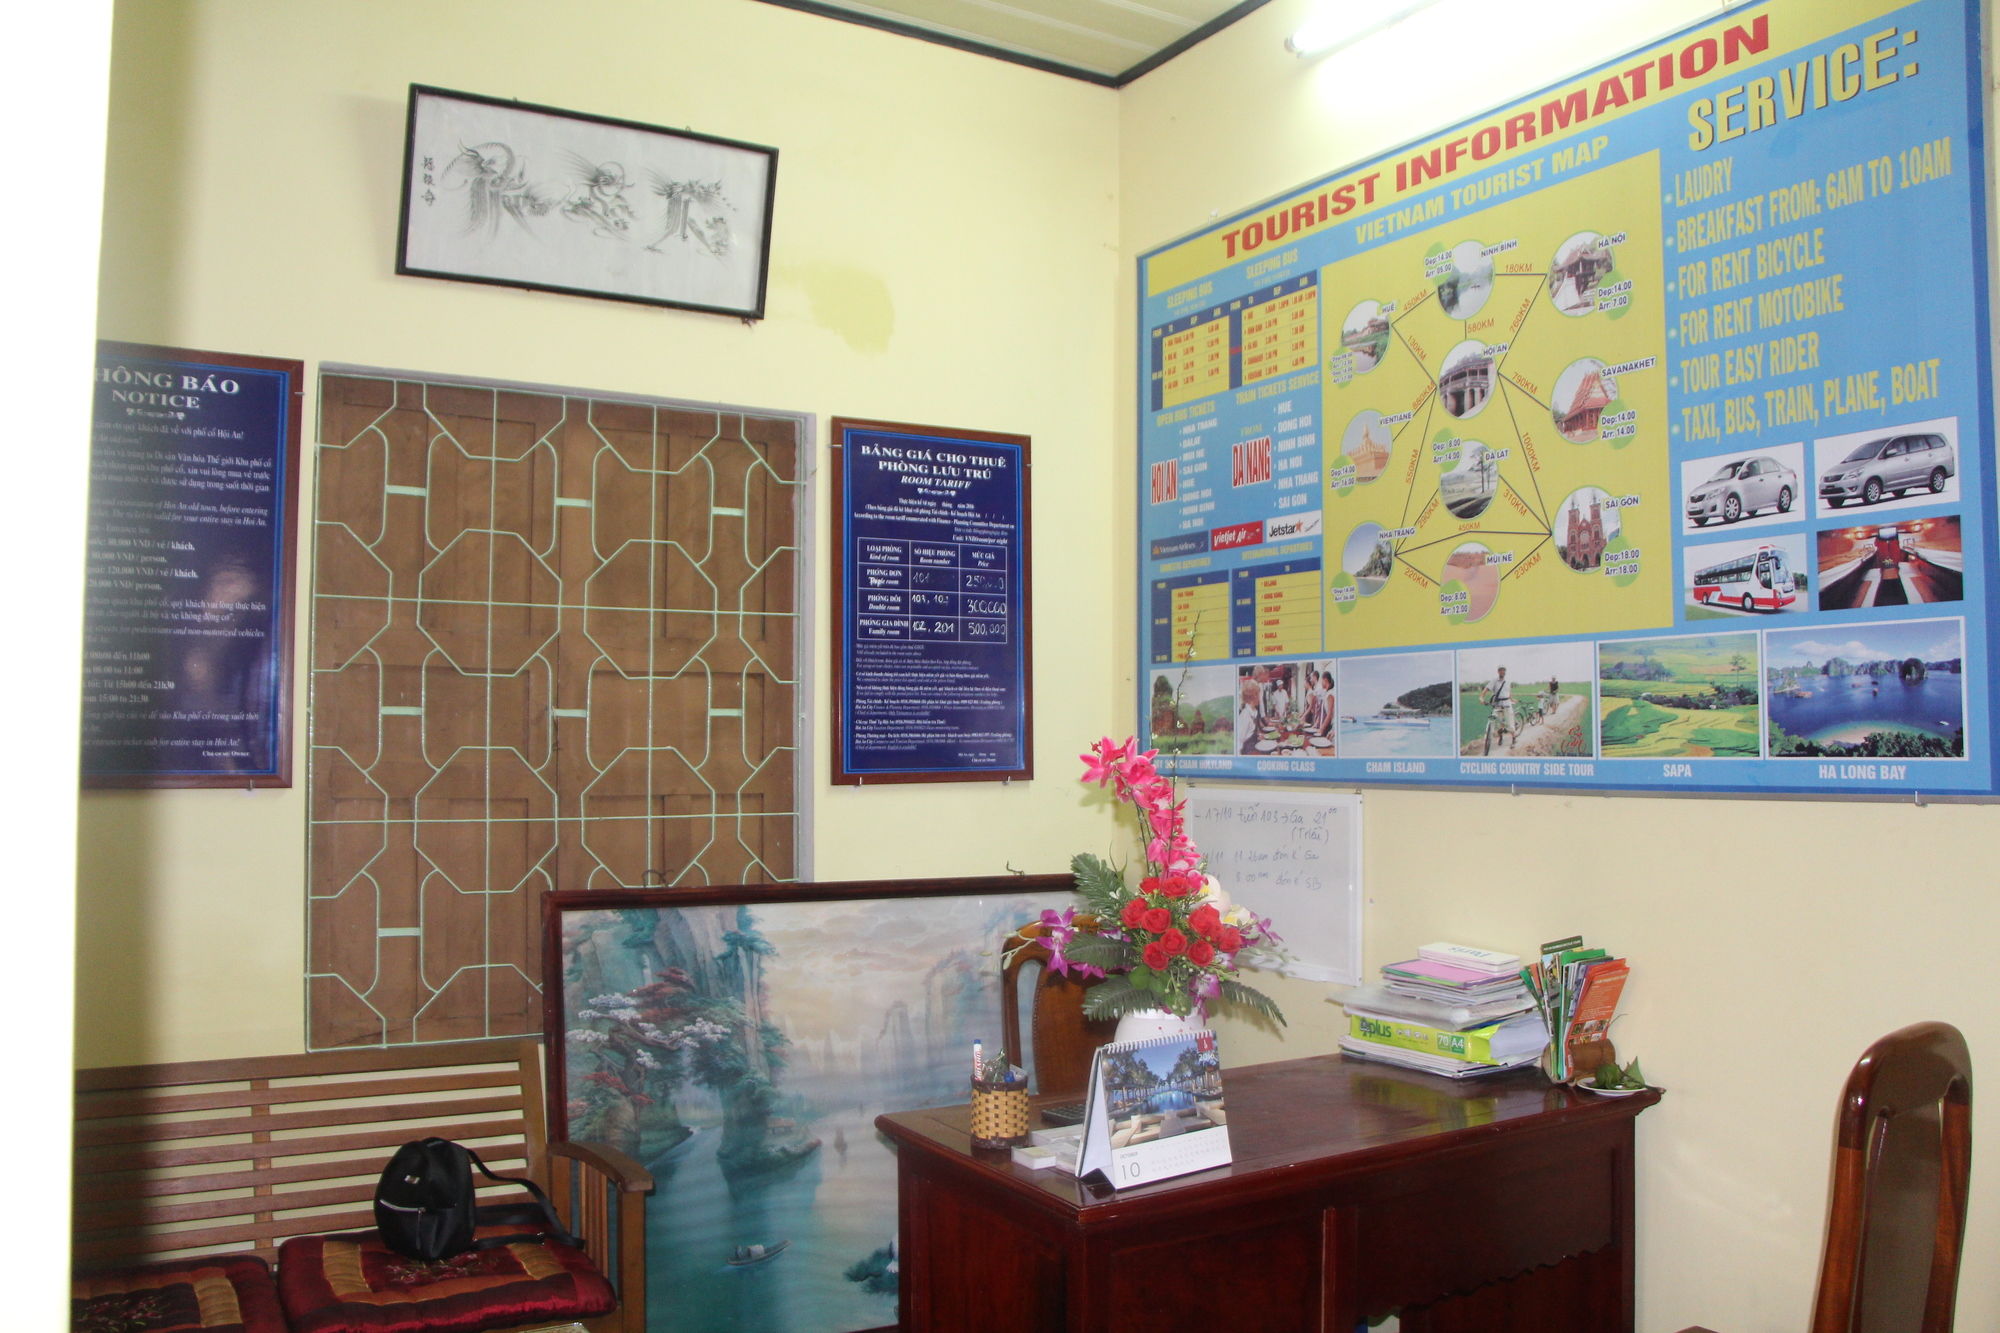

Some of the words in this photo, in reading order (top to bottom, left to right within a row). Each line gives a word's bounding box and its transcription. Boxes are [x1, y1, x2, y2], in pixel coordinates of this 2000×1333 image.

[1687, 26, 1918, 152] SERVICE:
[1222, 172, 1380, 259] TOURIST
[1396, 13, 1769, 192] INFORMATION
[1355, 195, 1445, 244] VIETNAM
[1450, 158, 1545, 211] TOURIST
[1552, 135, 1609, 174] MAP
[1675, 156, 1733, 207] LAUDRY
[1677, 194, 1764, 253] BREAKFAST
[1769, 179, 1821, 227] FROM:
[1826, 164, 1864, 210] 6AM
[1868, 155, 1893, 197] TO
[1899, 136, 1952, 189] 10AM
[1480, 246, 1498, 257] NINH
[1505, 264, 1533, 273] 180KM
[1678, 261, 1707, 300] FOR
[1711, 248, 1752, 291] RENT
[1757, 227, 1825, 280] BICYCLE
[1509, 298, 1531, 334] 760KM
[1679, 307, 1709, 347] FOR
[1713, 296, 1753, 339] RENT
[1758, 273, 1844, 329] MOTOBIKE
[1467, 318, 1495, 334] 580KM
[1407, 335, 1427, 361] 130KM
[1601, 357, 1656, 377] SAVANAKHET
[1680, 353, 1720, 394] TOUR
[1725, 343, 1764, 385] EASY
[1770, 331, 1819, 376] RIDER
[181, 374, 240, 395] BÁO
[1511, 371, 1538, 395] 790KM
[112, 388, 200, 409] NOTICE
[1278, 401, 1292, 414] HUE
[1682, 403, 1720, 443] TAXI,
[1724, 395, 1760, 436] BUS,
[1764, 383, 1819, 427] TRAIN,
[1824, 370, 1886, 416] PLANE,
[1891, 358, 1941, 405] BOAT
[1298, 414, 1312, 429] HOI
[1379, 411, 1413, 426] VIENTIANE
[1601, 411, 1636, 425] Dep:14.00
[1617, 425, 1635, 435] 14.00
[1278, 438, 1296, 452] NINH
[1297, 433, 1316, 448] BINH
[906, 448, 932, 460] GIÁ
[936, 453, 966, 464] CHO
[968, 456, 1006, 468] THUÊ
[1232, 442, 1244, 488] DA
[1245, 435, 1271, 485] NANG
[1278, 458, 1290, 471] HA
[1291, 456, 1303, 468] NOI
[878, 459, 928, 475] PHÒNG
[932, 465, 961, 477] LƯU
[963, 467, 992, 480] TRÚ
[901, 475, 932, 485] ROOM
[934, 478, 972, 490] TARIFF
[1151, 461, 1164, 505] HOI
[1165, 458, 1178, 503] AN
[1278, 476, 1293, 489] NHA
[1294, 471, 1319, 487] TRANG
[1278, 496, 1291, 509] SAI
[1292, 493, 1307, 507] GON
[1503, 489, 1527, 517] 310KM
[1269, 524, 1296, 538] Jetstar
[1379, 531, 1393, 539] NHA
[1394, 527, 1416, 538] TRANG
[1605, 549, 1639, 562] Dep:18.00
[1514, 553, 1542, 580] 230KM
[1404, 567, 1429, 590] 220KM
[934, 621, 954, 633] 201
[153, 681, 175, 690] 21h30
[1257, 760, 1289, 771] COOKING
[1290, 761, 1315, 772] CLASS
[1366, 762, 1391, 773] CHAM
[1393, 762, 1425, 774] ISLAND
[1460, 762, 1496, 774] CYCLING
[1499, 763, 1541, 775] COUNTRY
[1543, 763, 1566, 776] SIDE
[1568, 764, 1594, 777] TOUR
[1663, 763, 1692, 777] SAPA
[1819, 764, 1837, 779] HA
[1841, 765, 1876, 779] LONG
[1880, 765, 1906, 780] BAY
[1438, 1035, 1449, 1046] 70
[1451, 1037, 1464, 1049] A4
[1122, 1162, 1141, 1180] 10
